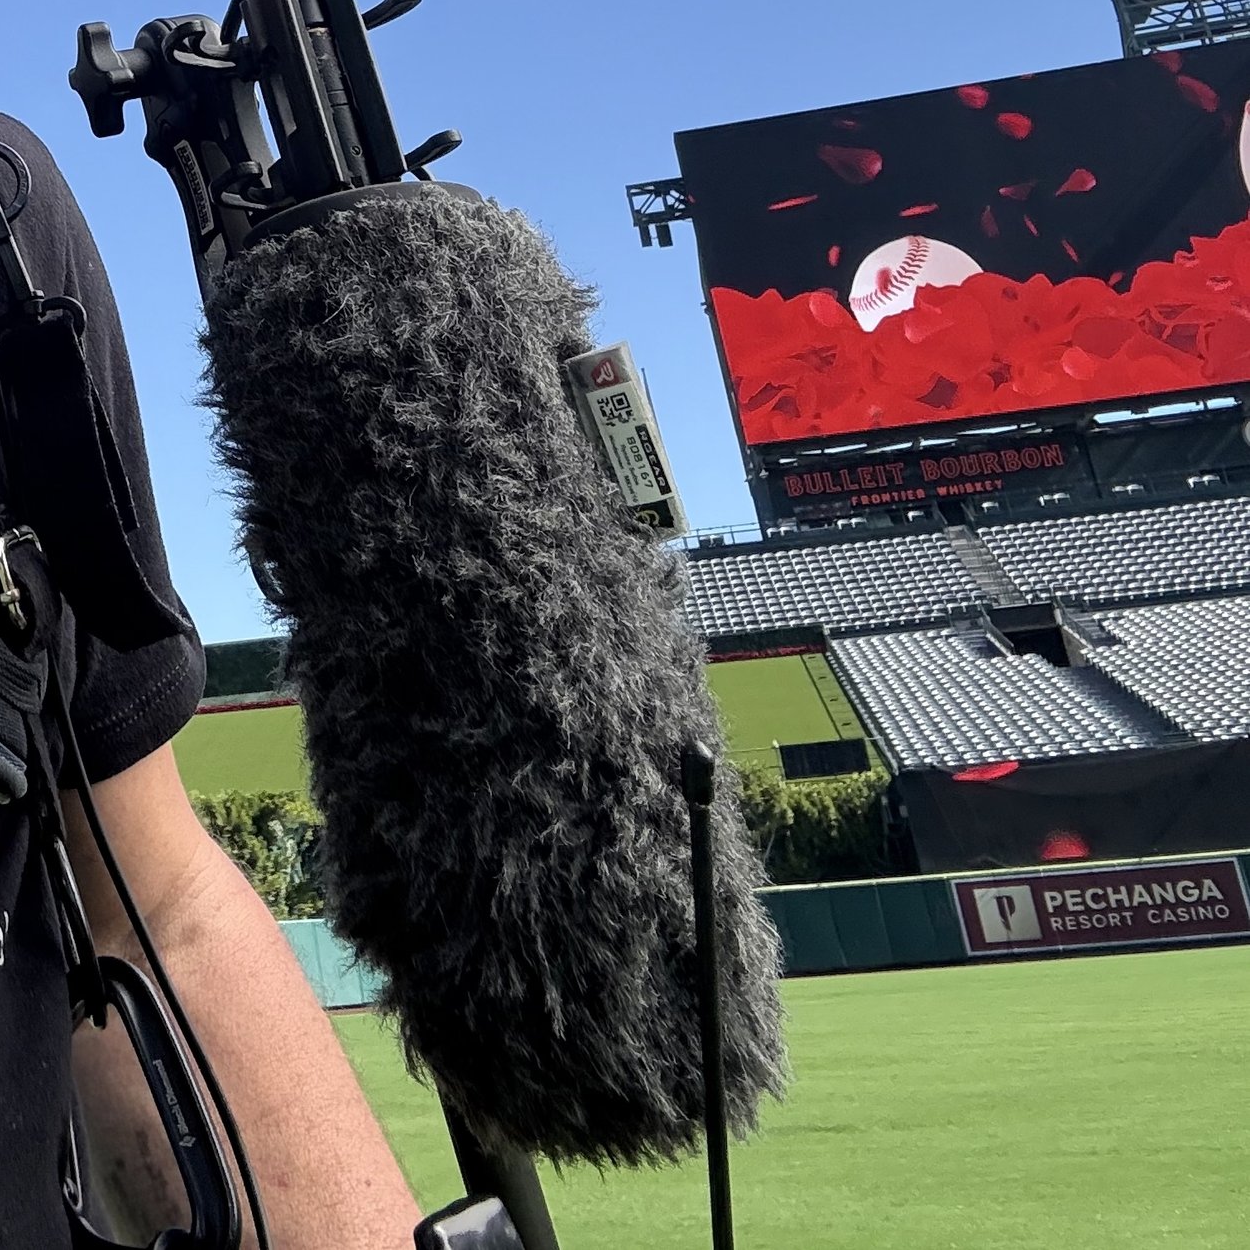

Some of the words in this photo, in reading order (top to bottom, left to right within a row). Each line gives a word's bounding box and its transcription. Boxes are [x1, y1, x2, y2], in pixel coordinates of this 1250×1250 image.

[784, 462, 904, 497] BULLEIT
[920, 444, 1065, 482] BOURBON
[852, 487, 927, 506] FRONTIER
[937, 478, 1003, 496] WHISKEY
[1044, 878, 1224, 913] PECHANGA
[1051, 911, 1134, 932] RESORT
[1147, 904, 1231, 924] CASINO
